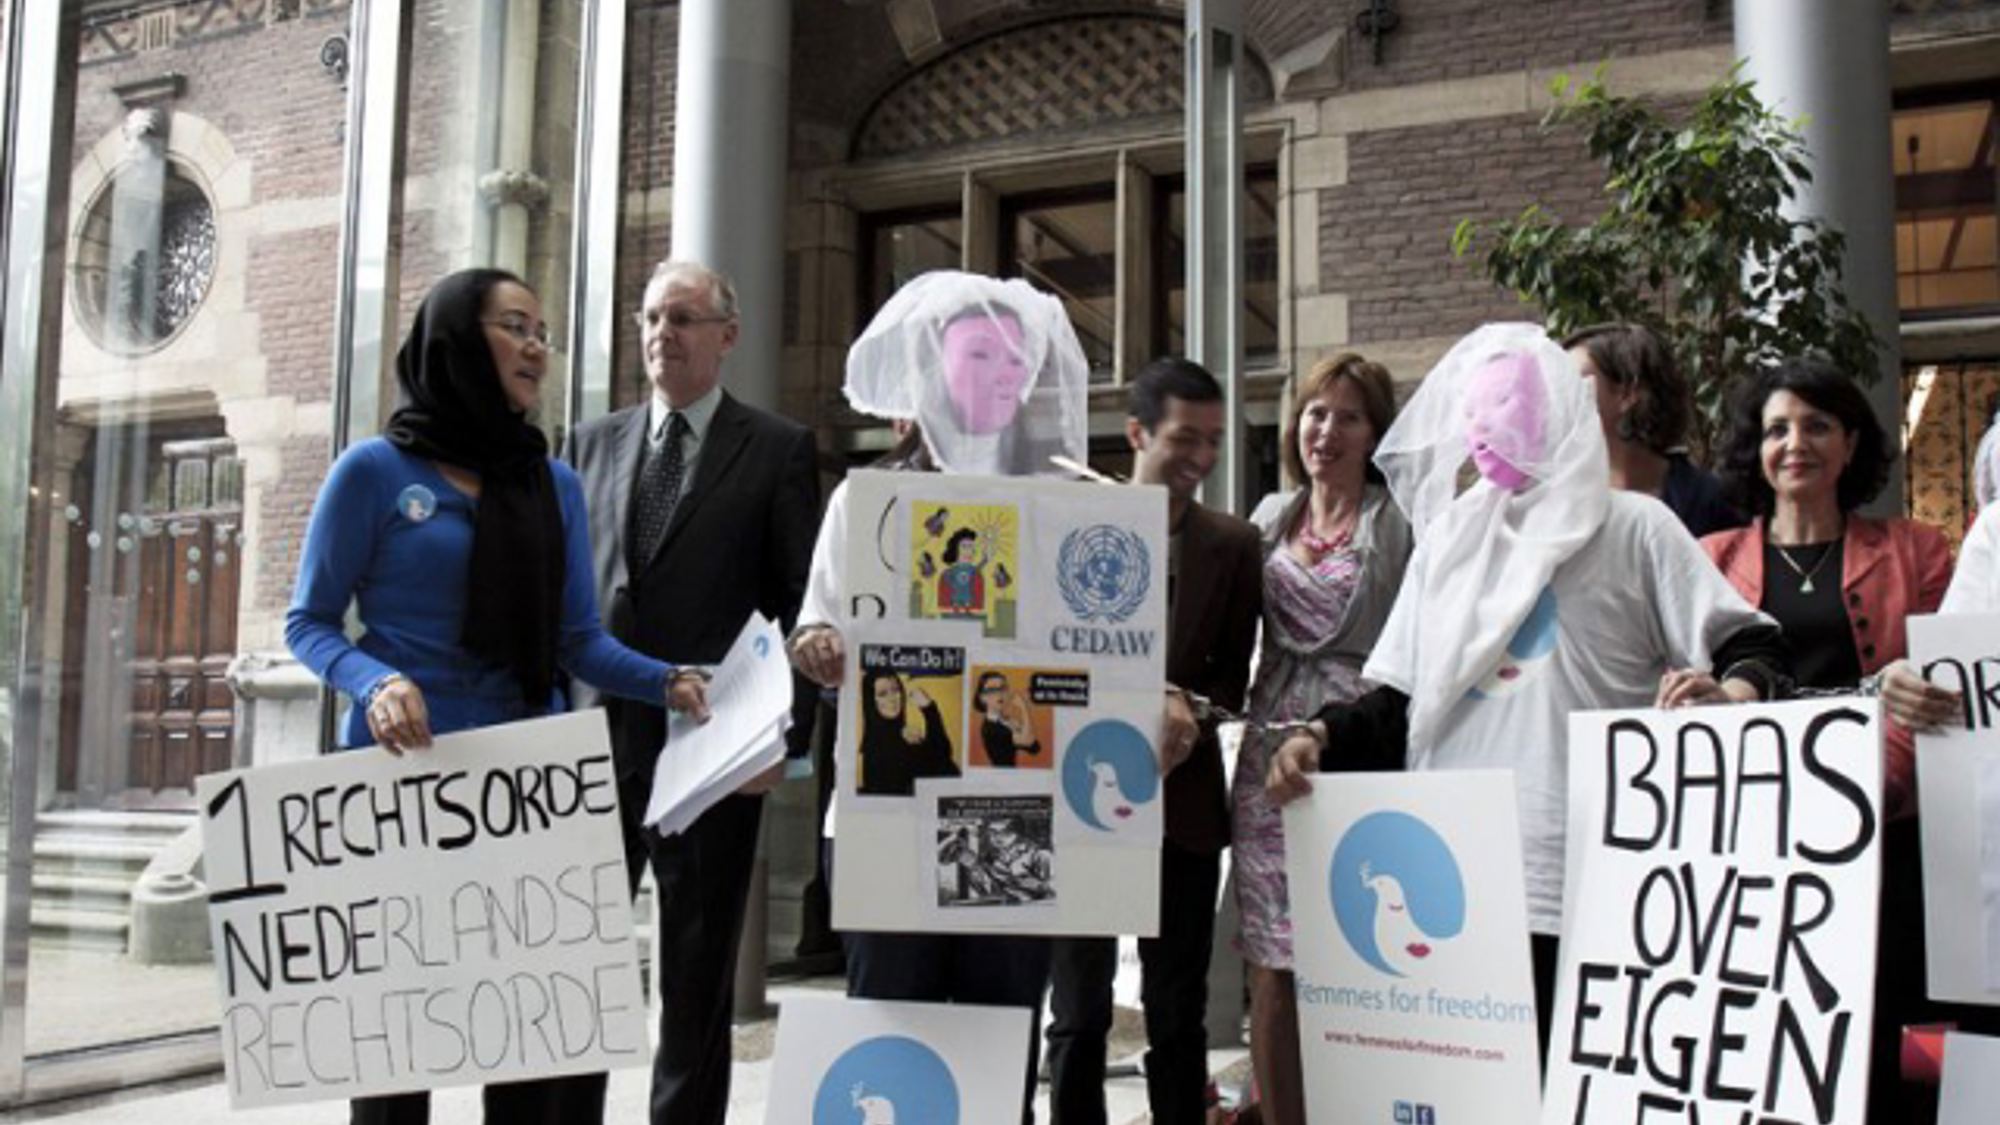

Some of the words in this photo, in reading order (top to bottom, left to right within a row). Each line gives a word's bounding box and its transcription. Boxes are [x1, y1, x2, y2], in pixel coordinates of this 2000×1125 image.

[865, 650, 886, 667] We
[890, 650, 916, 667] Can
[920, 650, 940, 668] Do
[1050, 625, 1154, 656] CEDAW
[208, 776, 287, 904] 1
[279, 755, 617, 873] RECHTSORDE
[1602, 707, 1877, 864] BAAS
[223, 860, 629, 997] NEDERLANDSE
[1632, 861, 1841, 1015] OVER
[224, 963, 637, 1095] RECHTSORDE
[1388, 983, 1420, 1013] for
[1427, 987, 1534, 1023] freedom
[1569, 962, 1853, 1125] EIGEN
